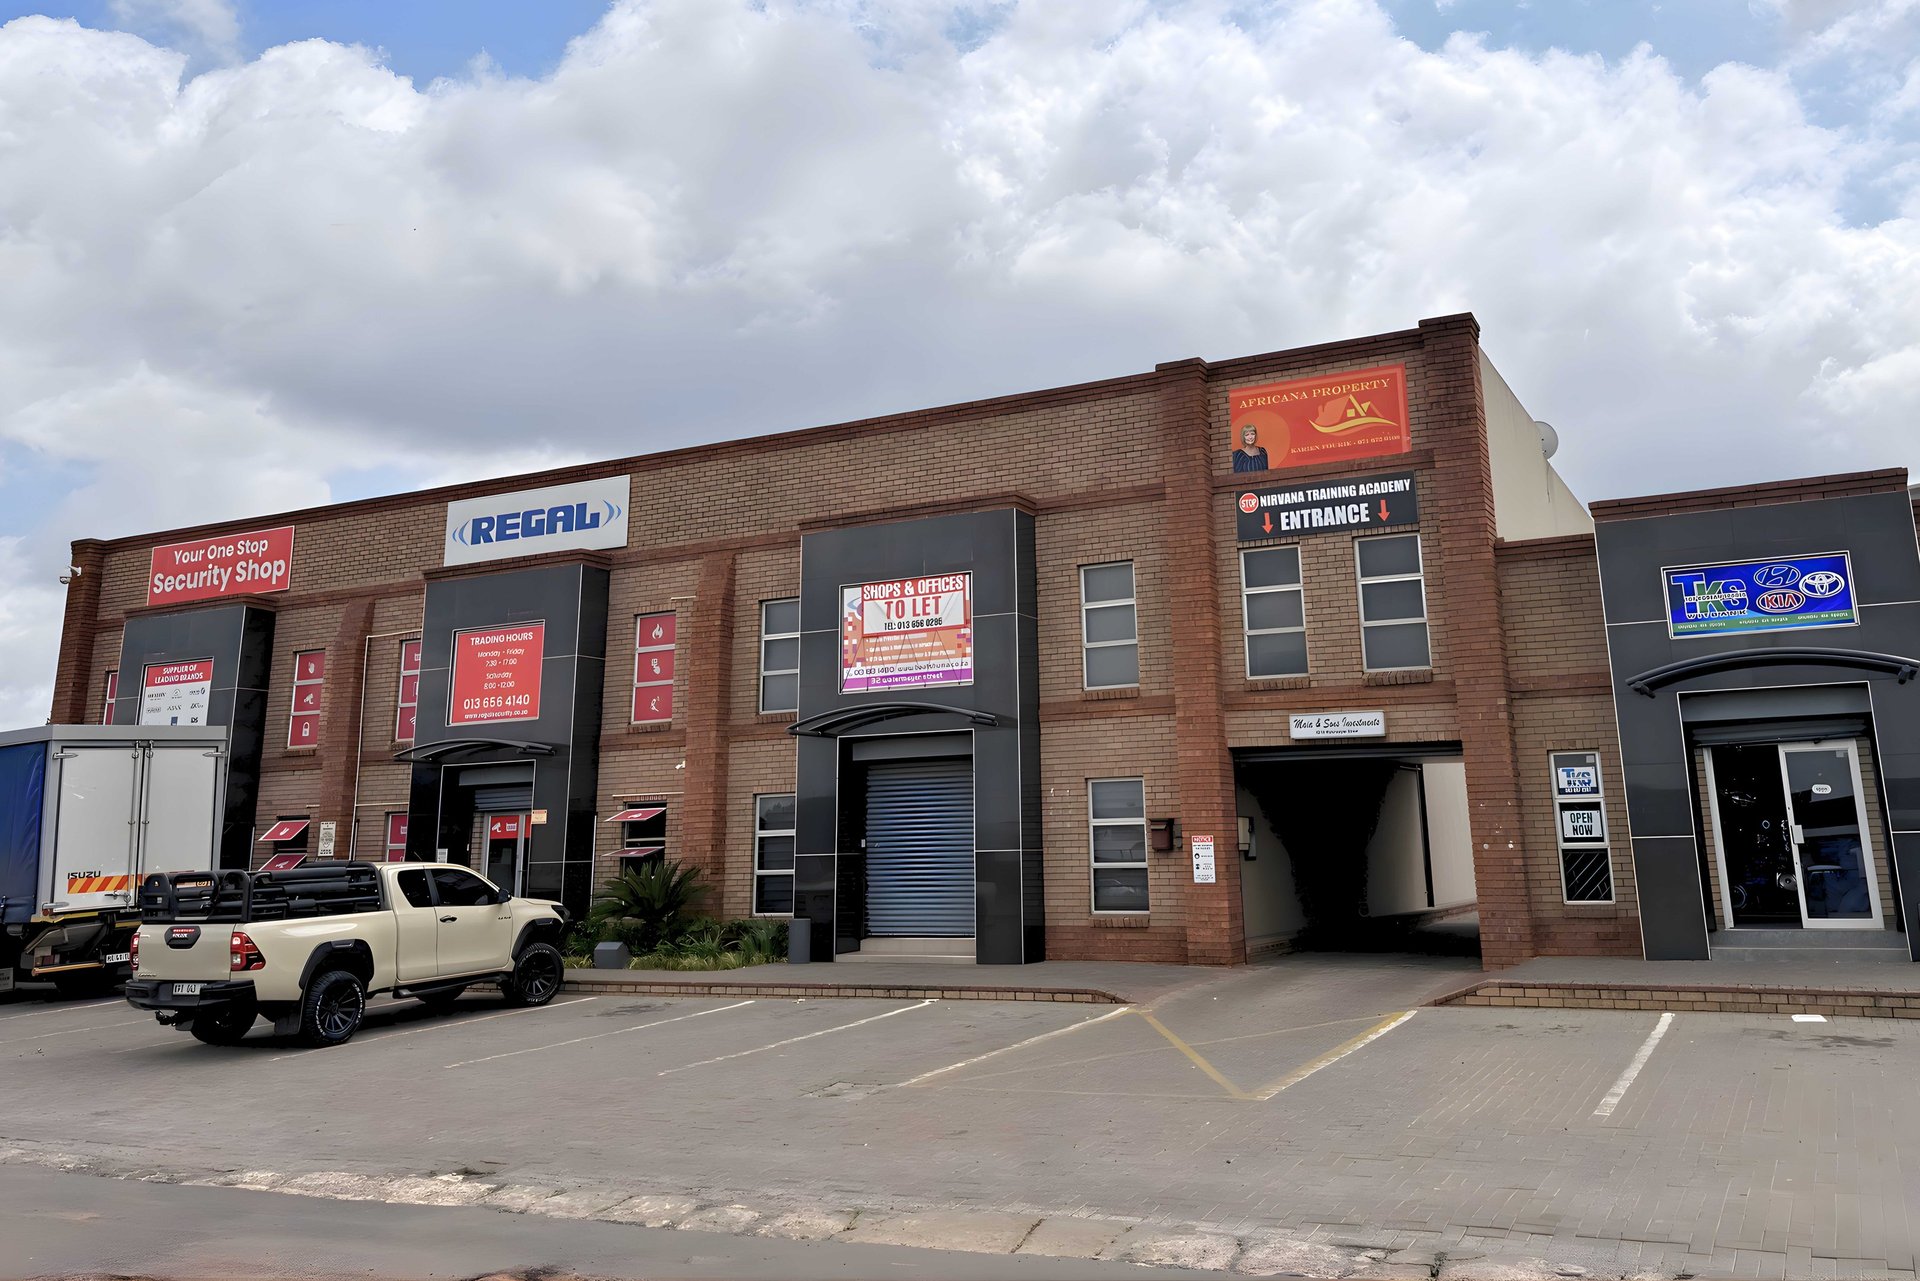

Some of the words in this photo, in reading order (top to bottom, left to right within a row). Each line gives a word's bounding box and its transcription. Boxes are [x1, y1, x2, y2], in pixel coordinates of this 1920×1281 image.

[1239, 391, 1308, 409] AFRICANA
[1313, 378, 1390, 398] PROPERTY
[1241, 497, 1257, 509] STOP
[1260, 490, 1305, 508] NIRVANA
[1306, 484, 1357, 502] TRAINING
[1358, 479, 1411, 496] ACADEMY
[470, 502, 600, 546] REGAL
[1280, 503, 1370, 531] ENTRANCE
[174, 549, 205, 565] Your
[207, 545, 234, 560] One
[237, 539, 268, 557] Stop
[153, 563, 232, 594] Security
[235, 559, 286, 584] Shop
[863, 582, 901, 600] SHOPS
[904, 581, 915, 596] &
[918, 574, 963, 593] OFFICES
[1670, 572, 1749, 614] TKS
[1764, 595, 1797, 609] KIA
[885, 599, 905, 620] TO
[912, 596, 941, 617] LET
[897, 621, 910, 630] 013
[470, 634, 505, 646] TRADING
[506, 632, 533, 643] HOURS
[463, 698, 480, 710] 013
[483, 696, 503, 708] 656
[505, 694, 530, 706] 4140
[1570, 812, 1593, 824] OPEN
[1572, 824, 1593, 836] NOW
[67, 870, 101, 880] ISUZU
